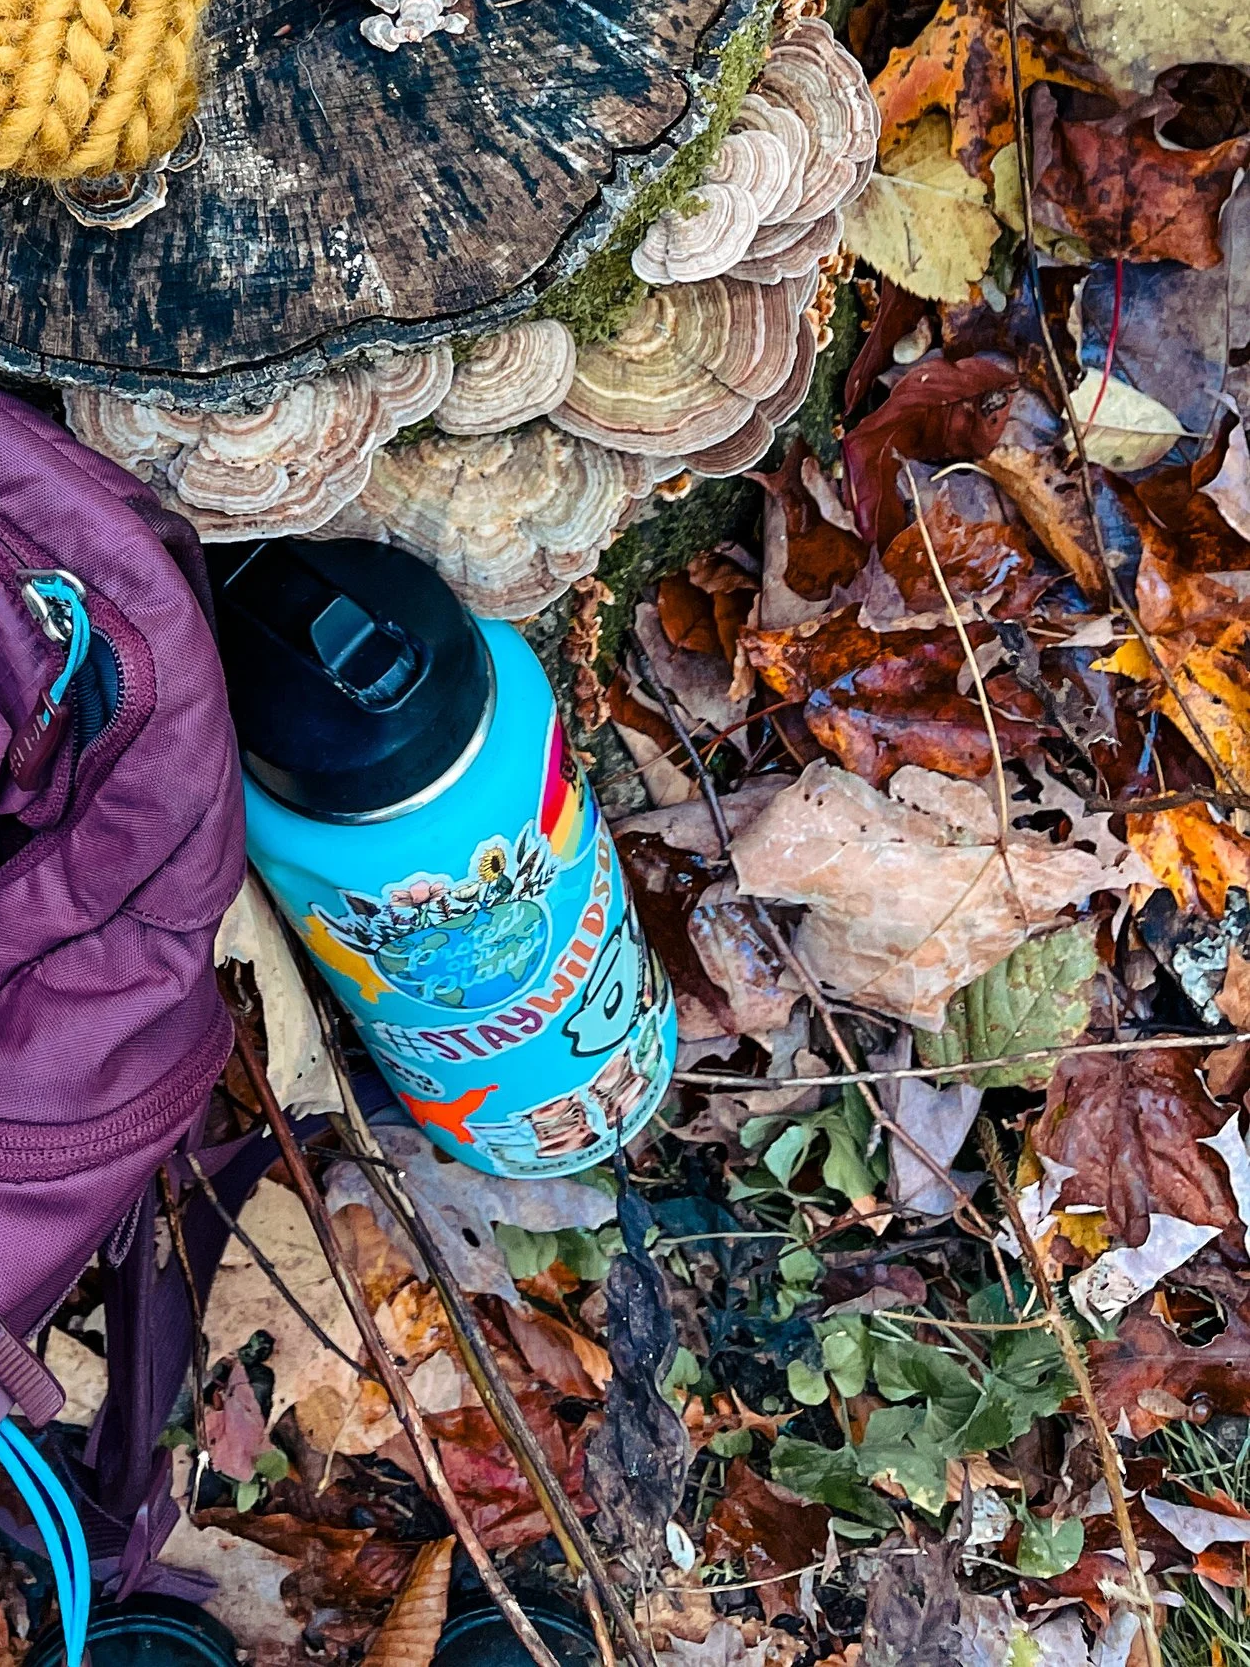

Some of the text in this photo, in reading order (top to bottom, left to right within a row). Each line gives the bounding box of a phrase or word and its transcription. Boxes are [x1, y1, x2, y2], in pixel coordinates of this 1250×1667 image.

[382, 900, 525, 972] Protect
[390, 919, 547, 1002] Planet
[445, 942, 503, 973] our
